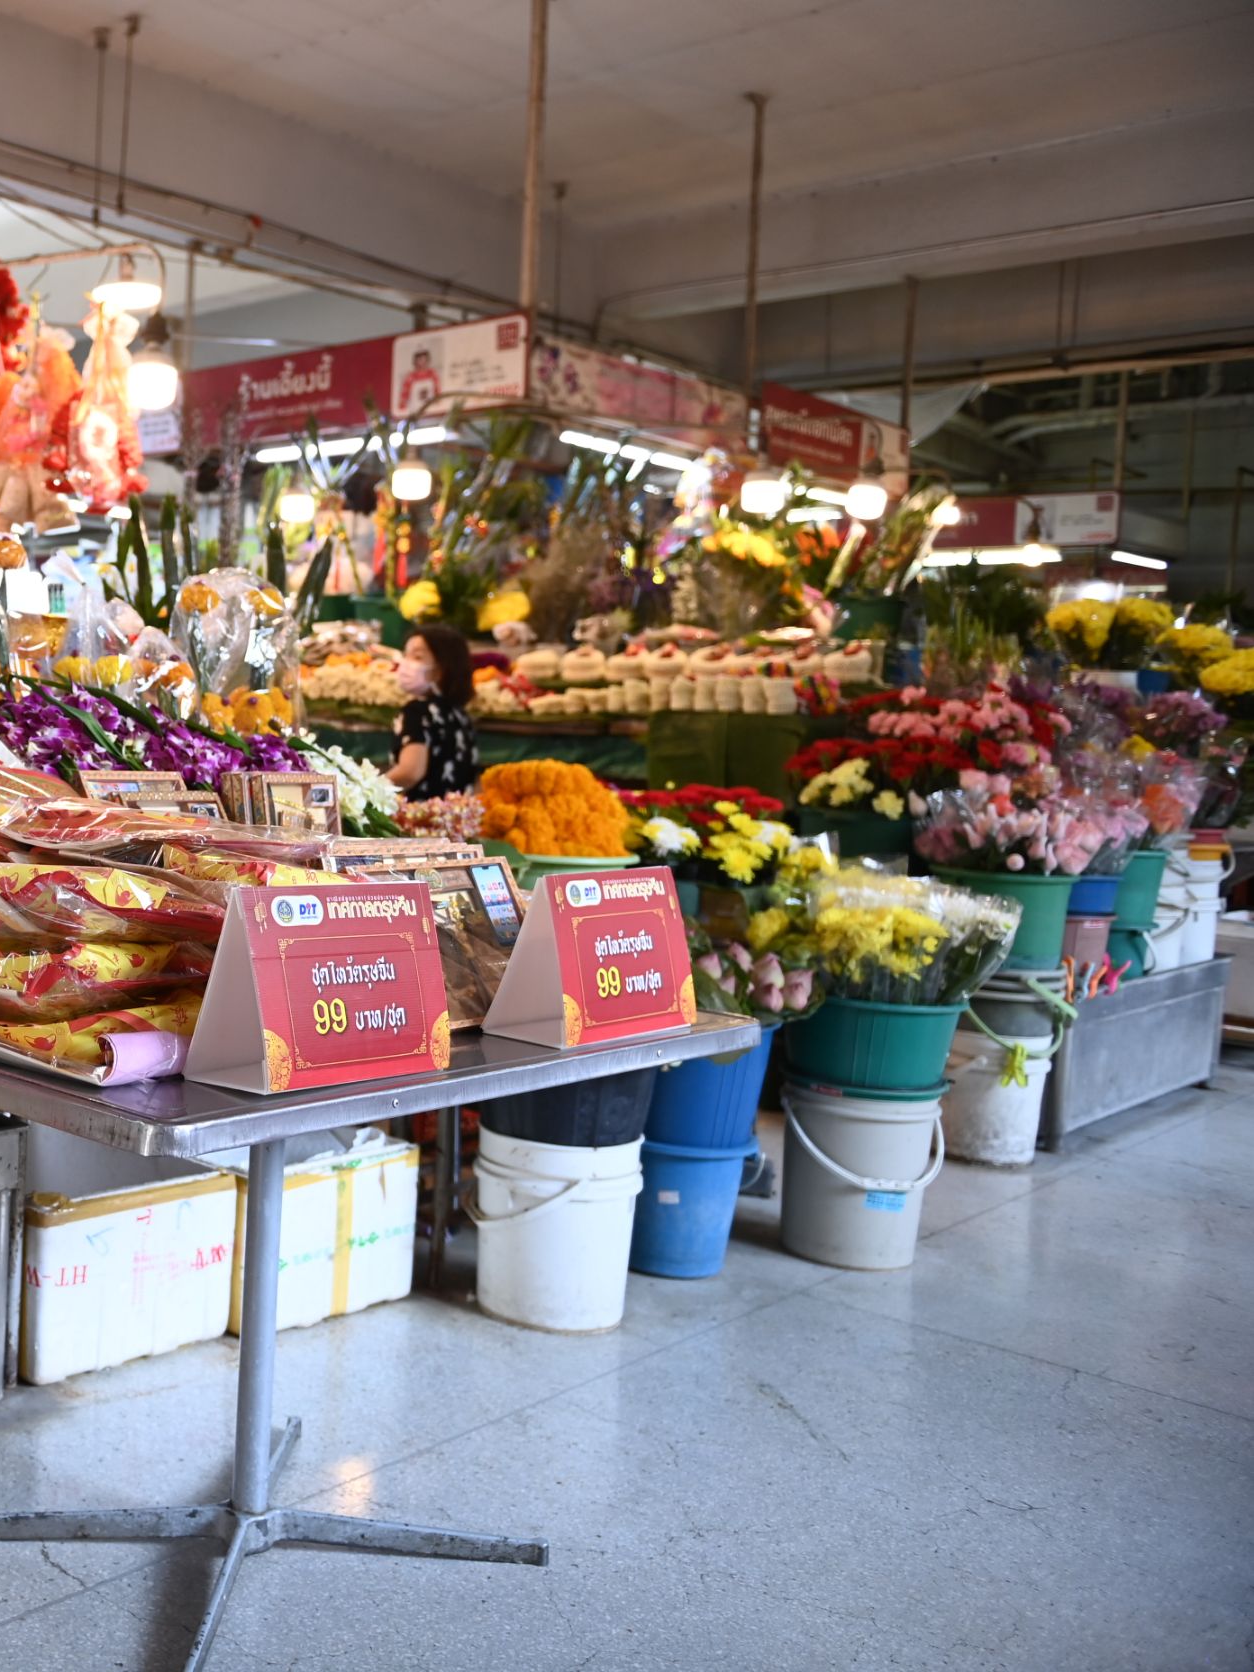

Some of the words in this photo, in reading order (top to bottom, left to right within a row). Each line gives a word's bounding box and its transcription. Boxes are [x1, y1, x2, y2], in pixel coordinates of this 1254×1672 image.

[326, 895, 417, 923] เทศกาลตรุษจีน
[594, 928, 653, 963] ชุดไหว้ตรุษจีน
[312, 956, 396, 994] ชุดไหว้ตรุษจีน
[596, 965, 622, 999] 99
[625, 968, 662, 996] บาท/ชุด
[313, 997, 348, 1035] 99
[355, 1002, 406, 1035] บาท/ชุด
